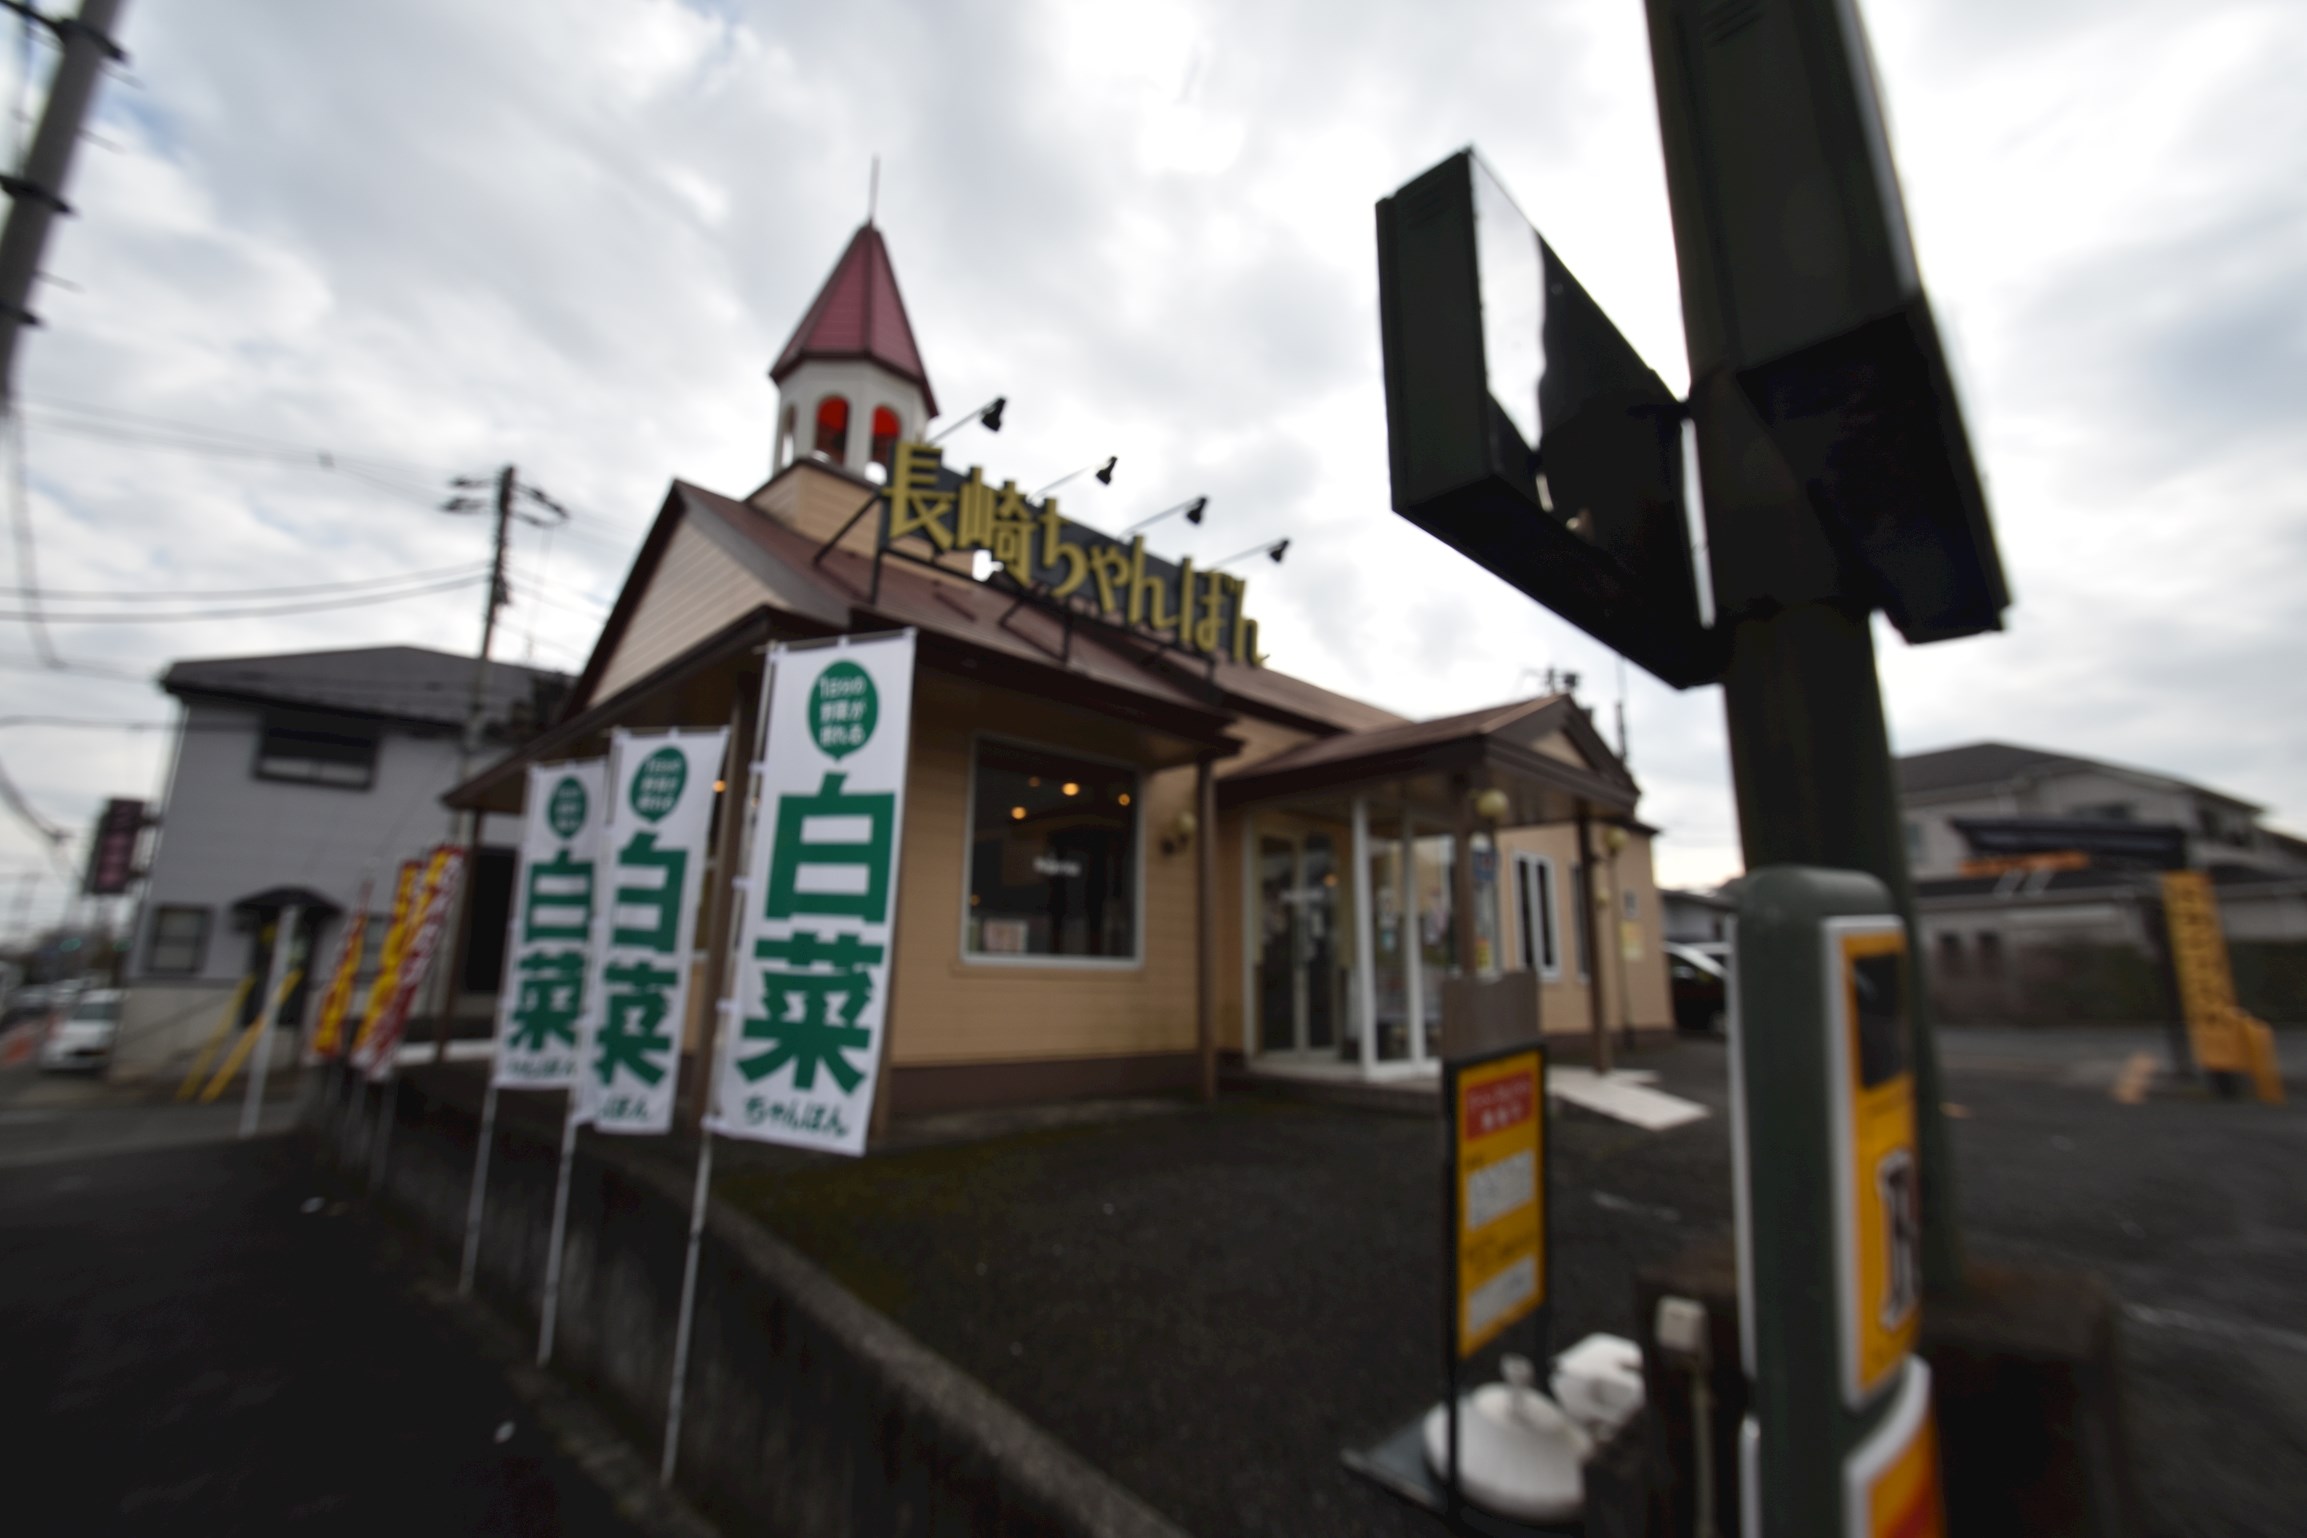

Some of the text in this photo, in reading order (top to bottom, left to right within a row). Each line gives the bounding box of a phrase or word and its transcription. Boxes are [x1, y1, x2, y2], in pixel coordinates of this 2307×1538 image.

[509, 850, 593, 1051] 白菜
[594, 831, 689, 1087] 白菜
[736, 771, 896, 1095] 白菜
